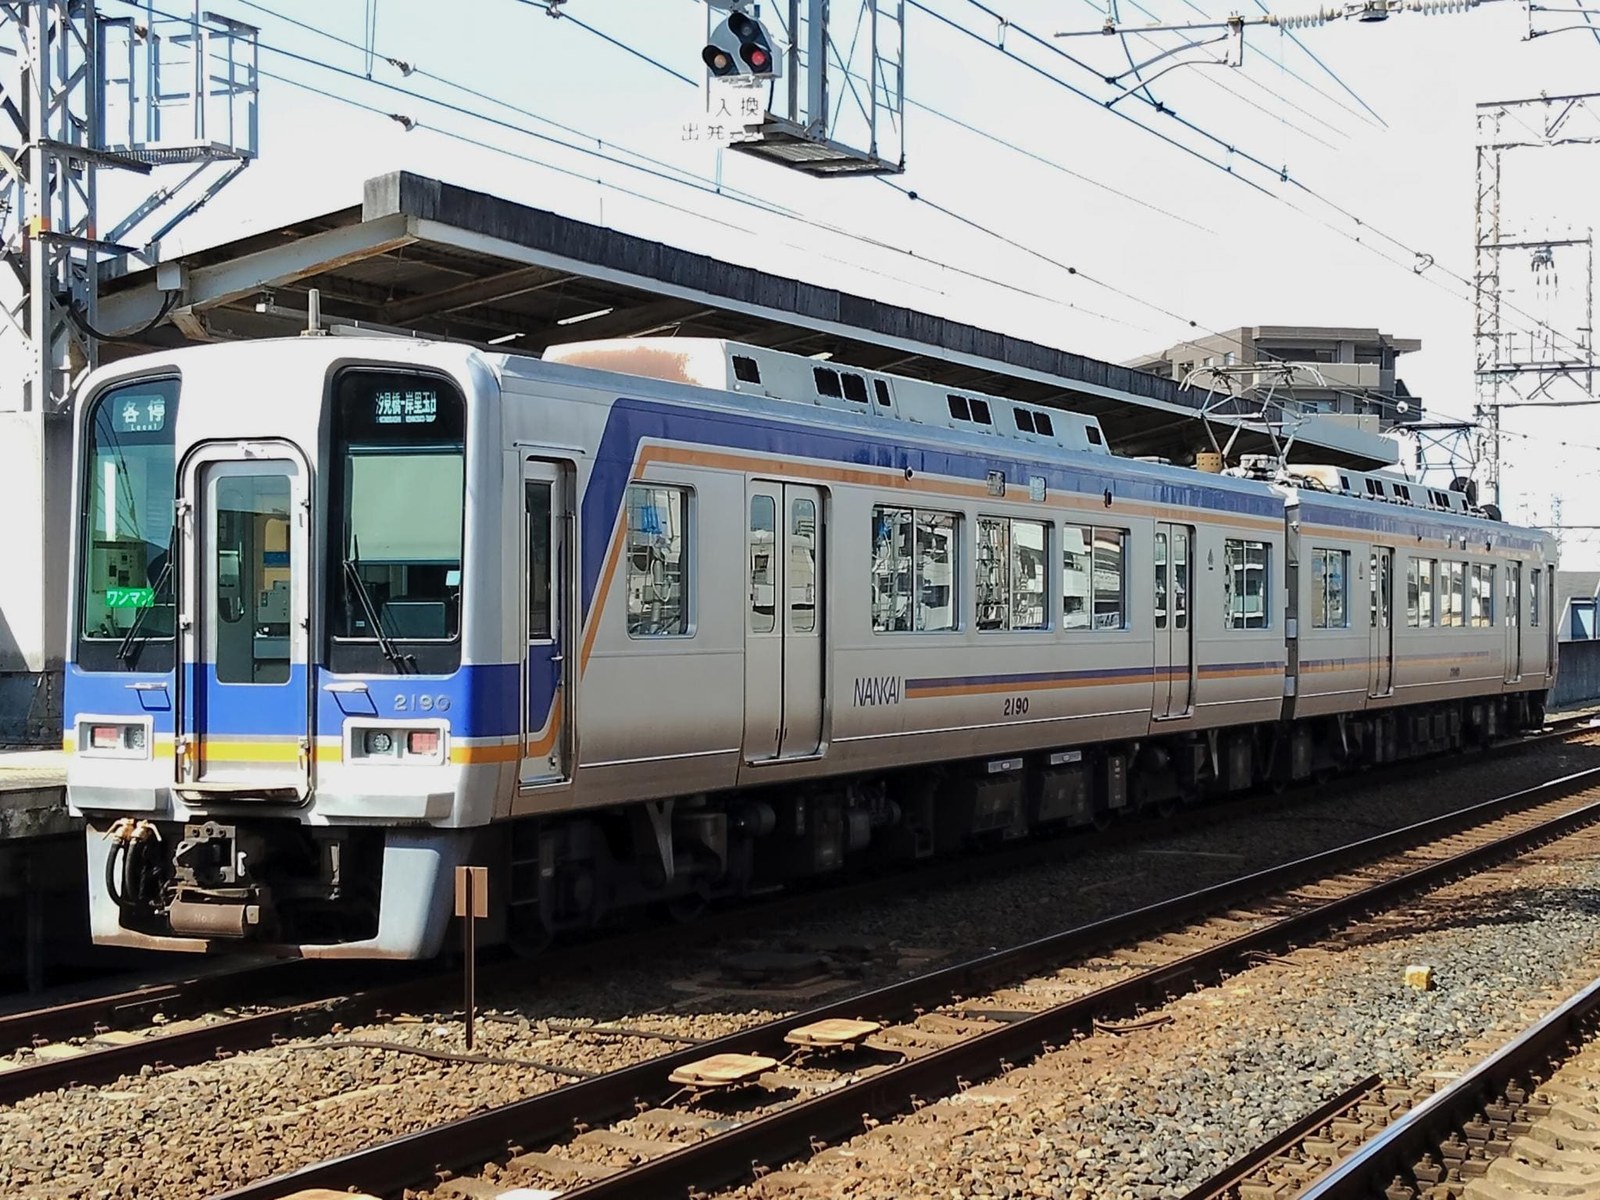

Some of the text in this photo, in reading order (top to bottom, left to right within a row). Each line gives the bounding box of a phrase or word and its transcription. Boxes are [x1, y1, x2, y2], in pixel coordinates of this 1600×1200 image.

[715, 97, 759, 117] 入換
[122, 399, 165, 423] 各停
[130, 423, 157, 431] Local
[106, 590, 153, 606] ワンマン
[853, 675, 901, 707] NANKAI
[393, 694, 452, 712] 2190
[1003, 697, 1029, 716] 2190
